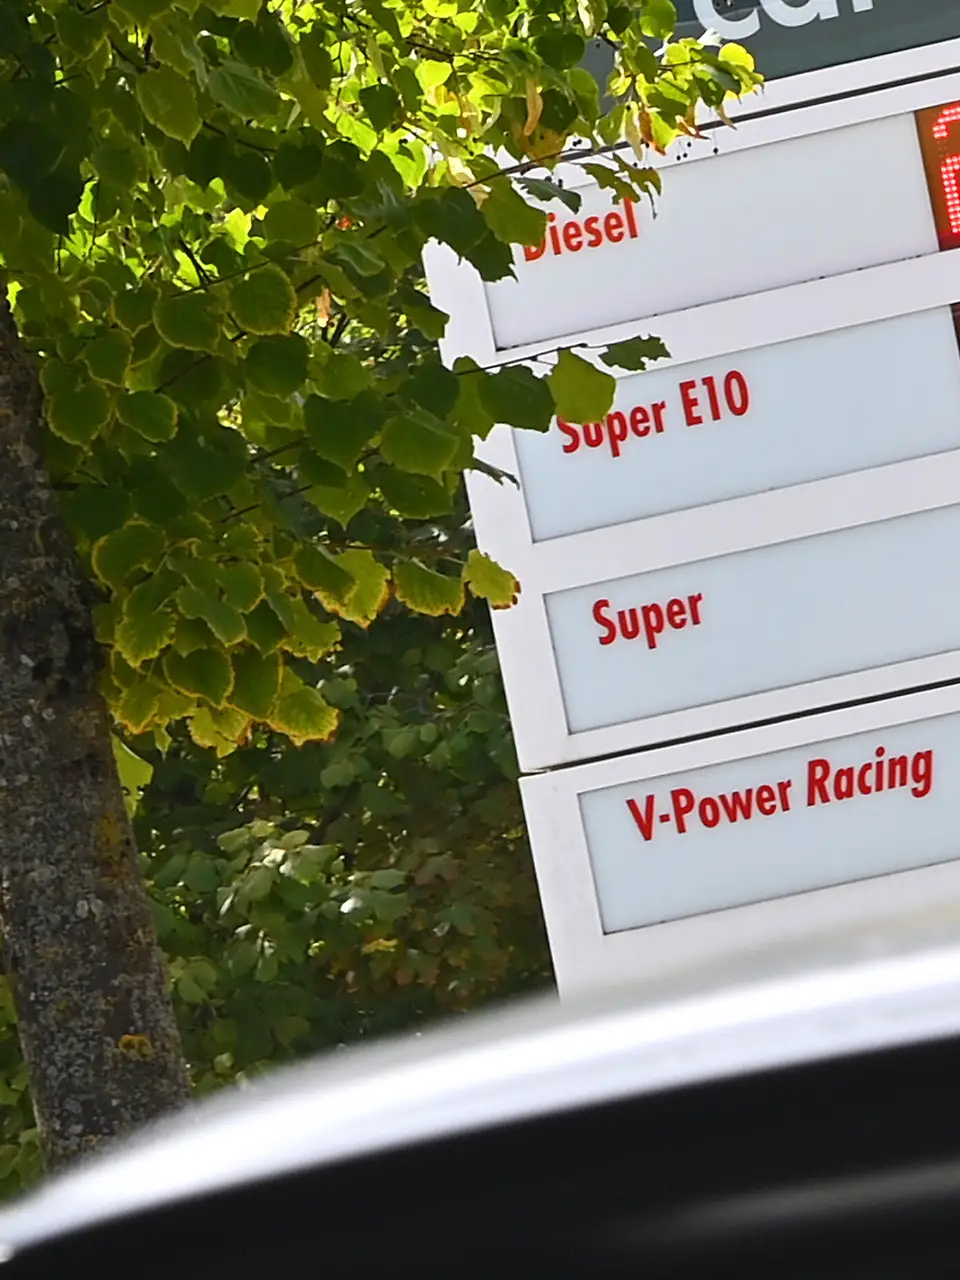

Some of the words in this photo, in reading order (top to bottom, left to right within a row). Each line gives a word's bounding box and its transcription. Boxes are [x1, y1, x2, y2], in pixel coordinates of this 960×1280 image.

[557, 400, 666, 458] Super
[679, 369, 750, 426] E10
[593, 592, 703, 649] Super
[627, 779, 792, 842] V-Power
[806, 746, 934, 809] Racing
